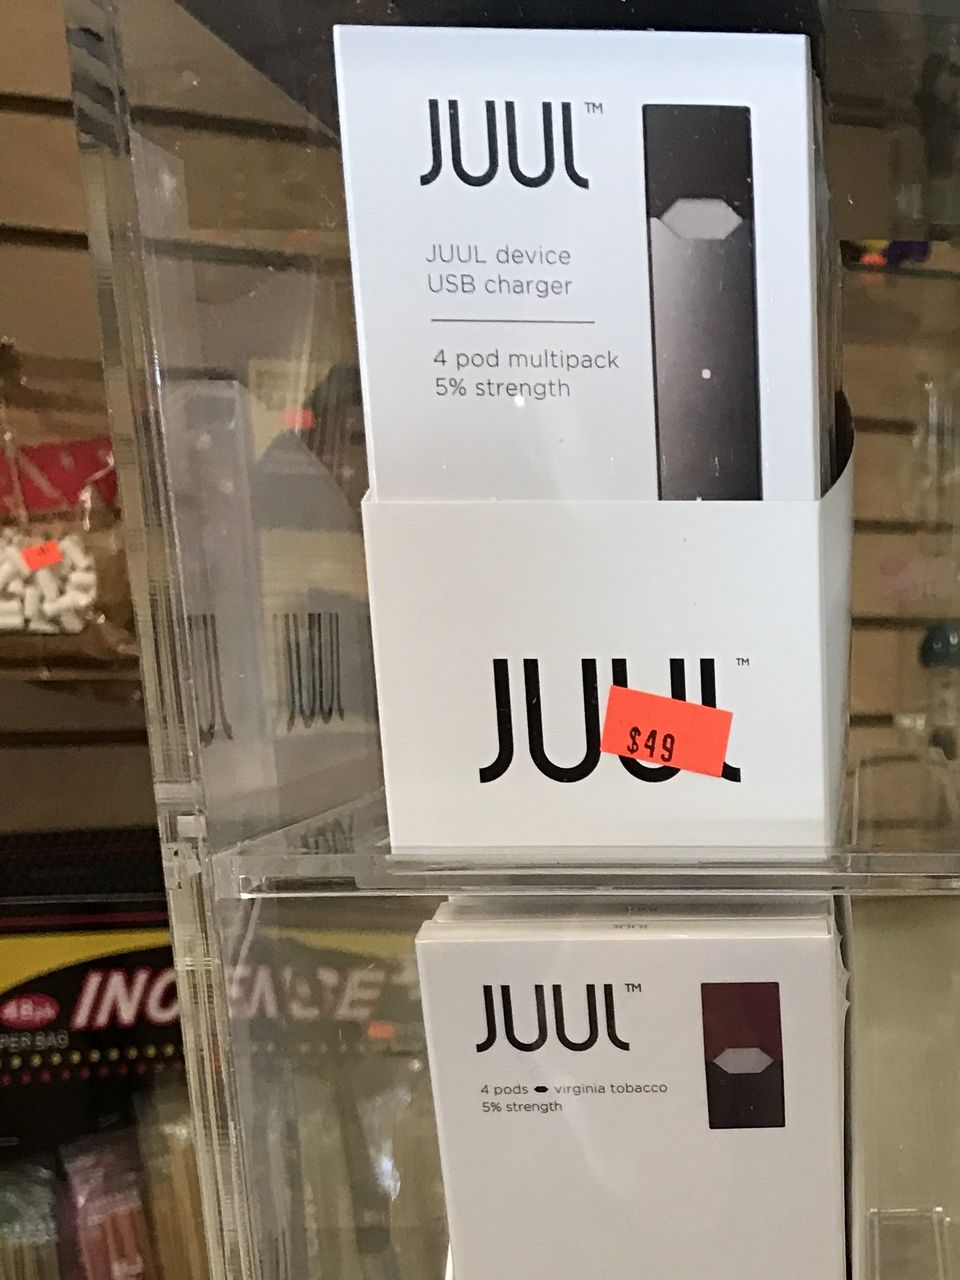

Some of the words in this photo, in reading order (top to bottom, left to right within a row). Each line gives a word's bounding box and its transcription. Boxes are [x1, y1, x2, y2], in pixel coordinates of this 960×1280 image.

[419, 98, 590, 190] JUUL
[425, 243, 487, 264] JUUL
[495, 244, 571, 266] device
[427, 273, 476, 294] USB
[484, 274, 573, 299] charger
[433, 349, 447, 367] 4
[455, 348, 500, 371] pod
[508, 349, 620, 372] multipack
[435, 377, 467, 397] 5%
[475, 377, 571, 401] strength
[626, 727, 675, 762] $49
[475, 983, 631, 1053] JUUL
[480, 1084, 490, 1095] 4
[493, 1084, 529, 1097] pods
[554, 1083, 606, 1096] virginia
[609, 1082, 668, 1094] tobacco
[482, 1101, 503, 1113] 5%
[505, 1100, 563, 1114] strength
